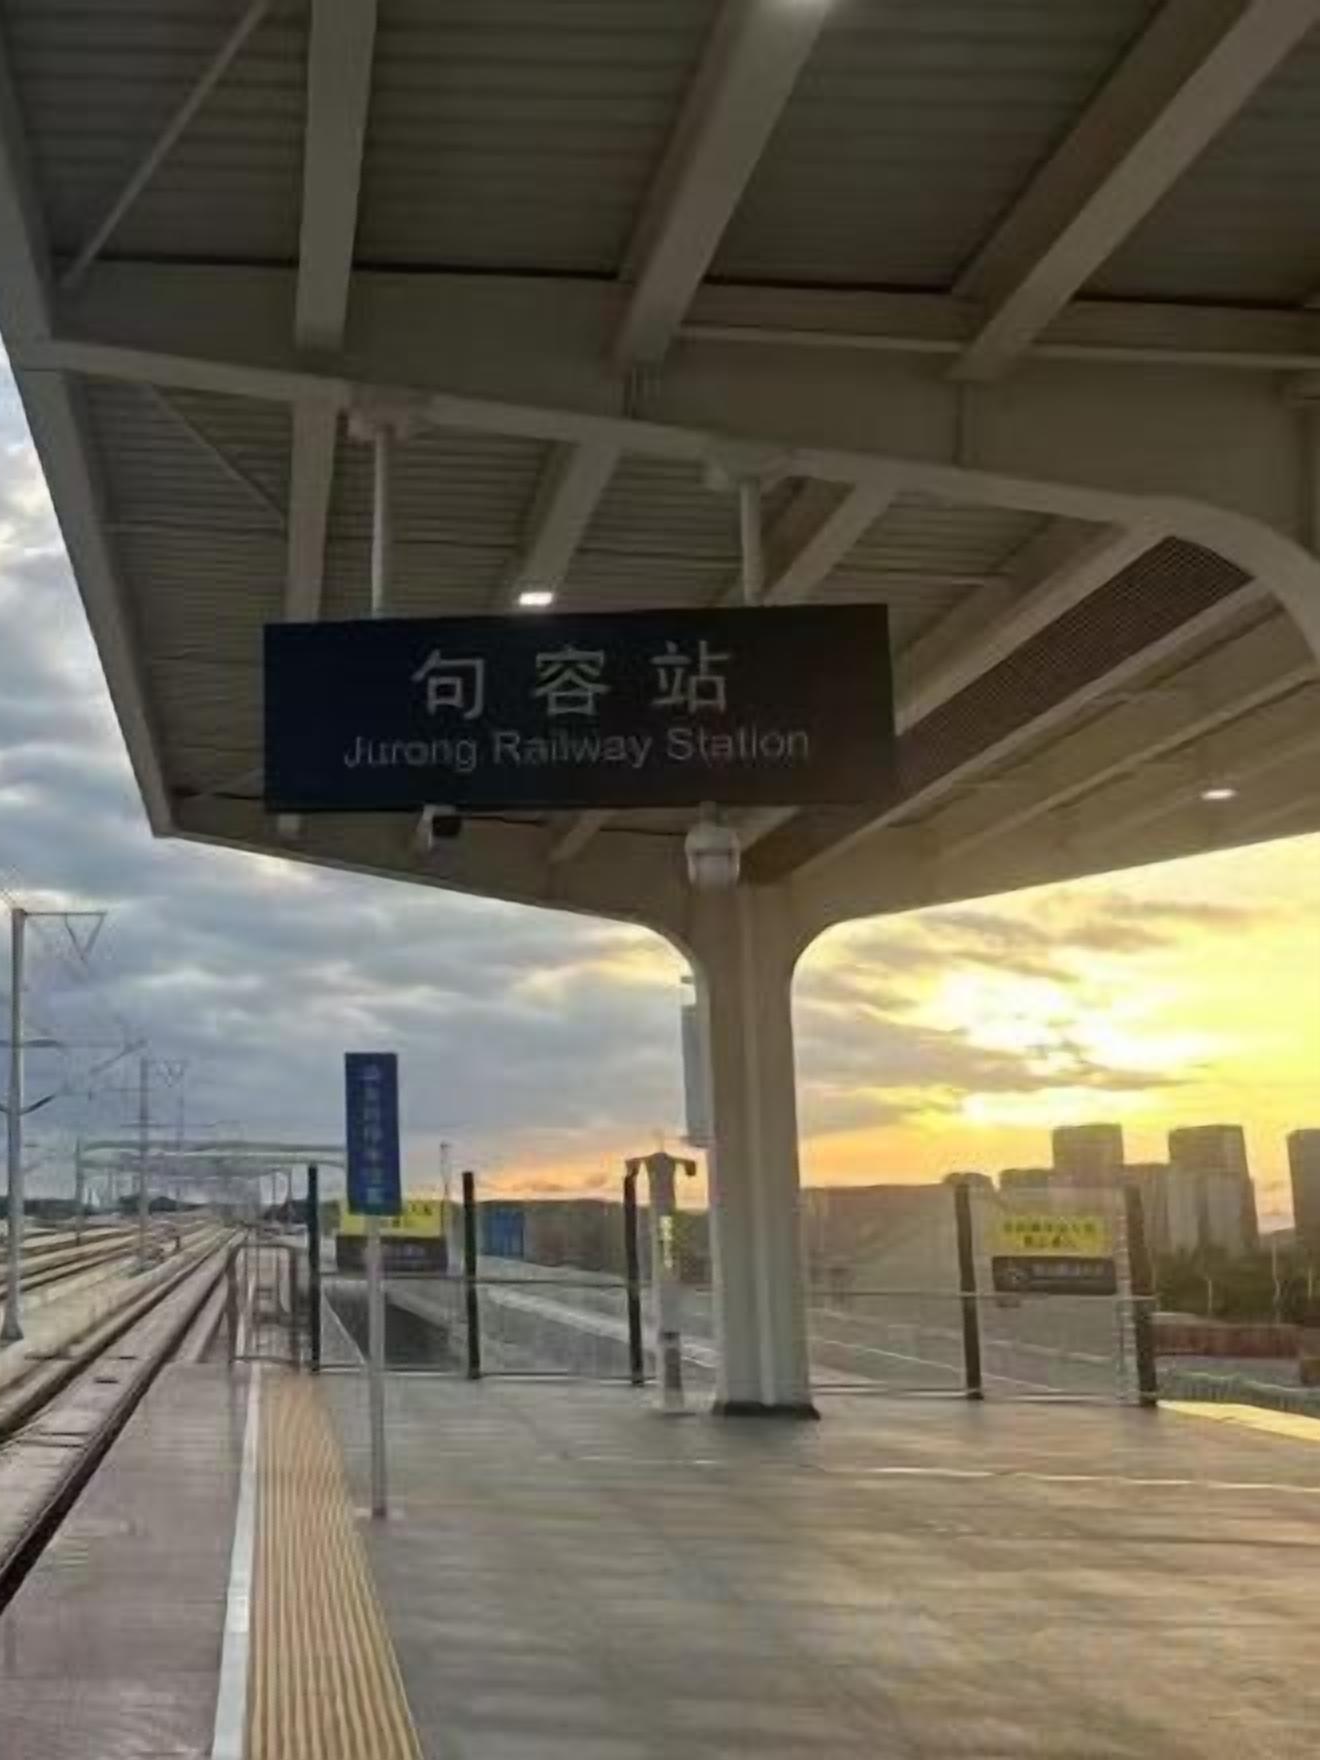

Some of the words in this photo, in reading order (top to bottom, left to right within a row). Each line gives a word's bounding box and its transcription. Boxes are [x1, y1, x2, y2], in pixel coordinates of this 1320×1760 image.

[412, 640, 730, 718] 句容站
[344, 734, 478, 772] Jurong
[493, 727, 653, 769] Railway
[667, 724, 810, 762] Station
